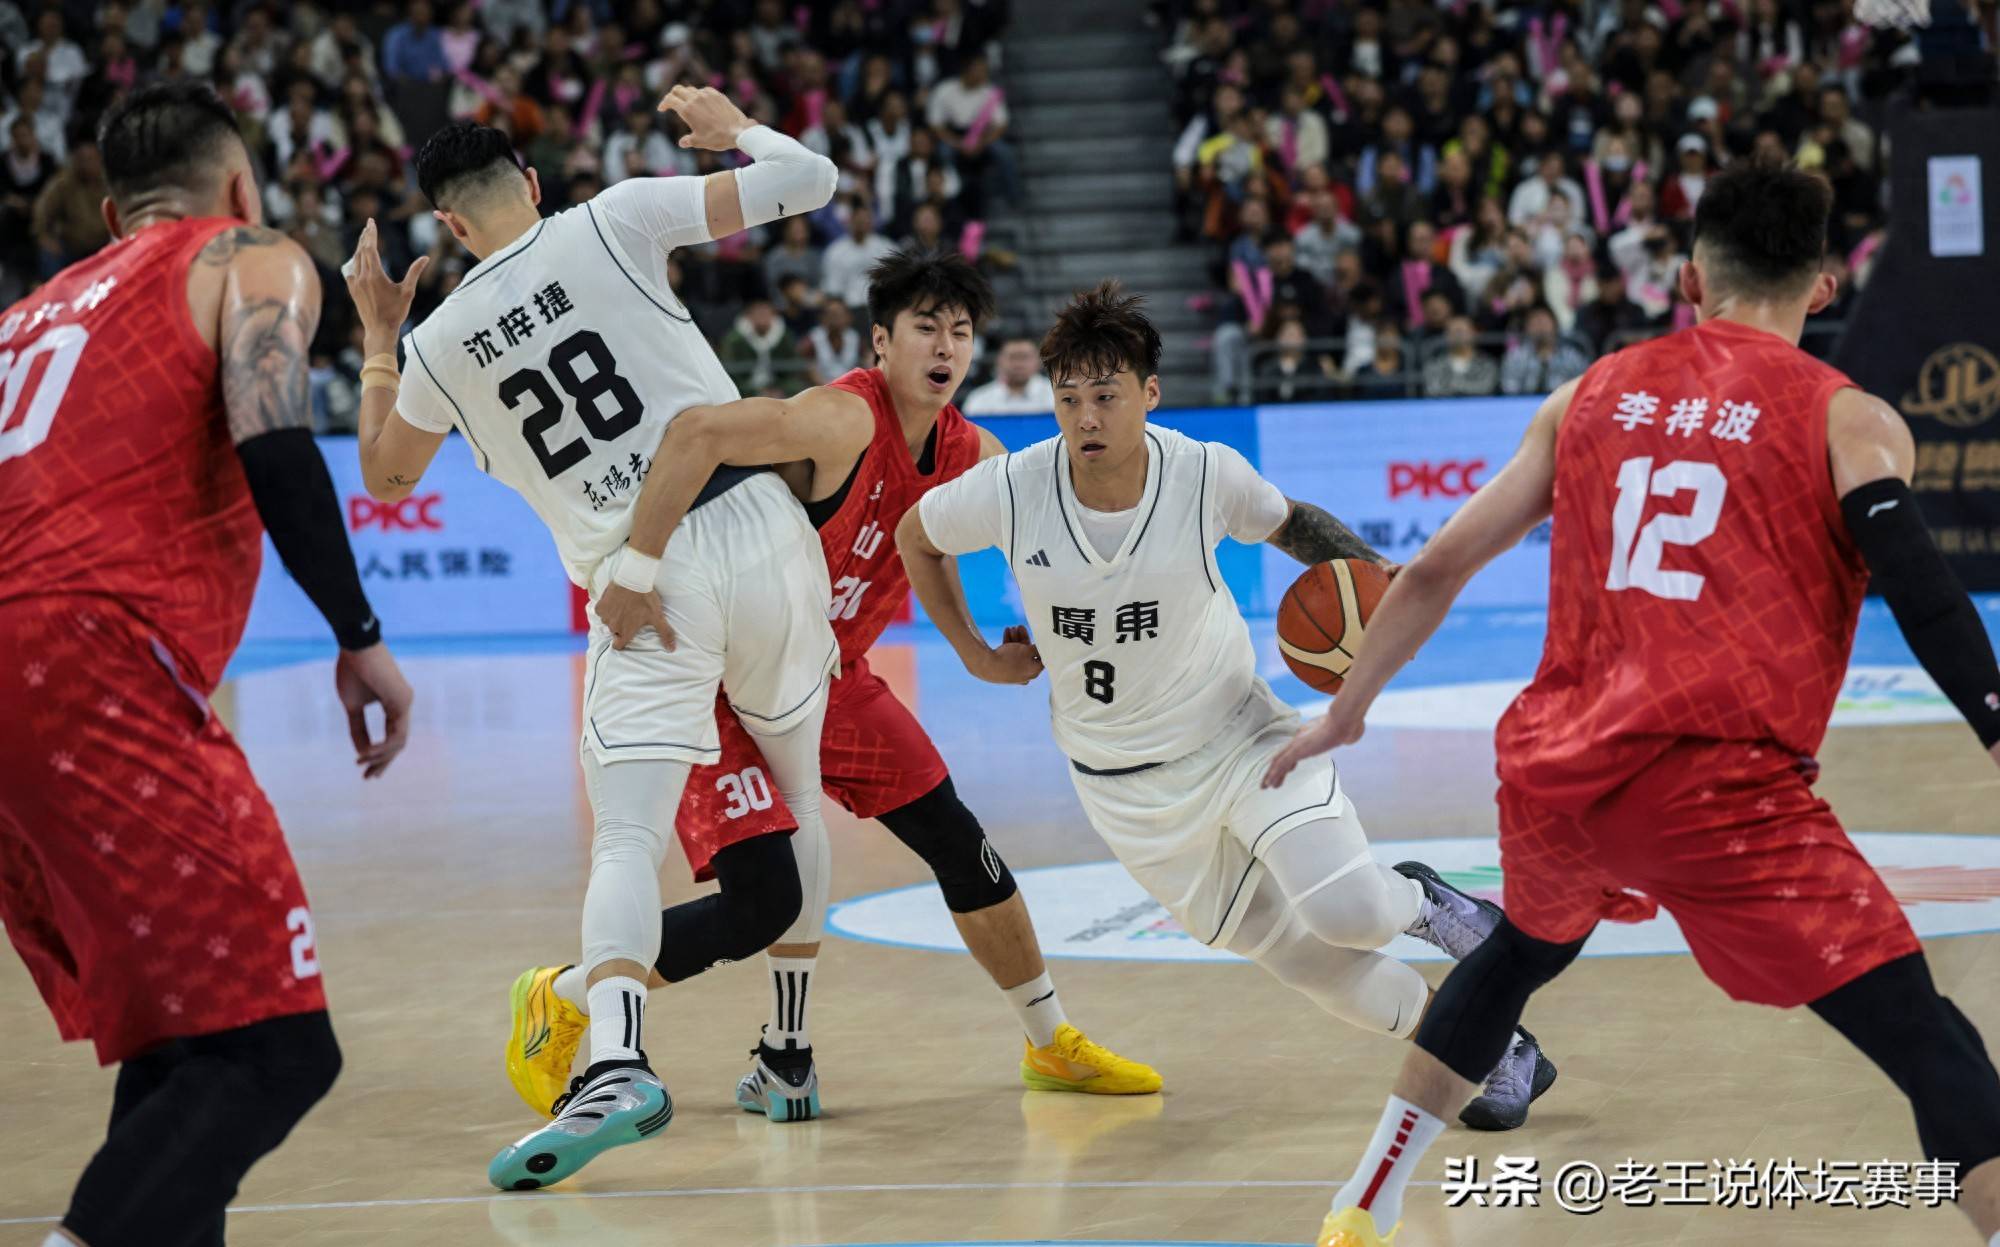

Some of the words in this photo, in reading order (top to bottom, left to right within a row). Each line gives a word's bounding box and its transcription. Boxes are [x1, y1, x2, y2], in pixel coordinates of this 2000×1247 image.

[463, 281, 574, 368] 沈梓捷
[0, 323, 90, 465] 0
[499, 330, 644, 480] 28
[1612, 391, 1760, 444] 李祥波
[1387, 459, 1486, 500] PICC
[348, 494, 444, 533] PICC
[1605, 456, 1728, 601] 12
[1051, 600, 1159, 647] 廣東
[1083, 660, 1115, 704] 8
[715, 766, 773, 819] 30
